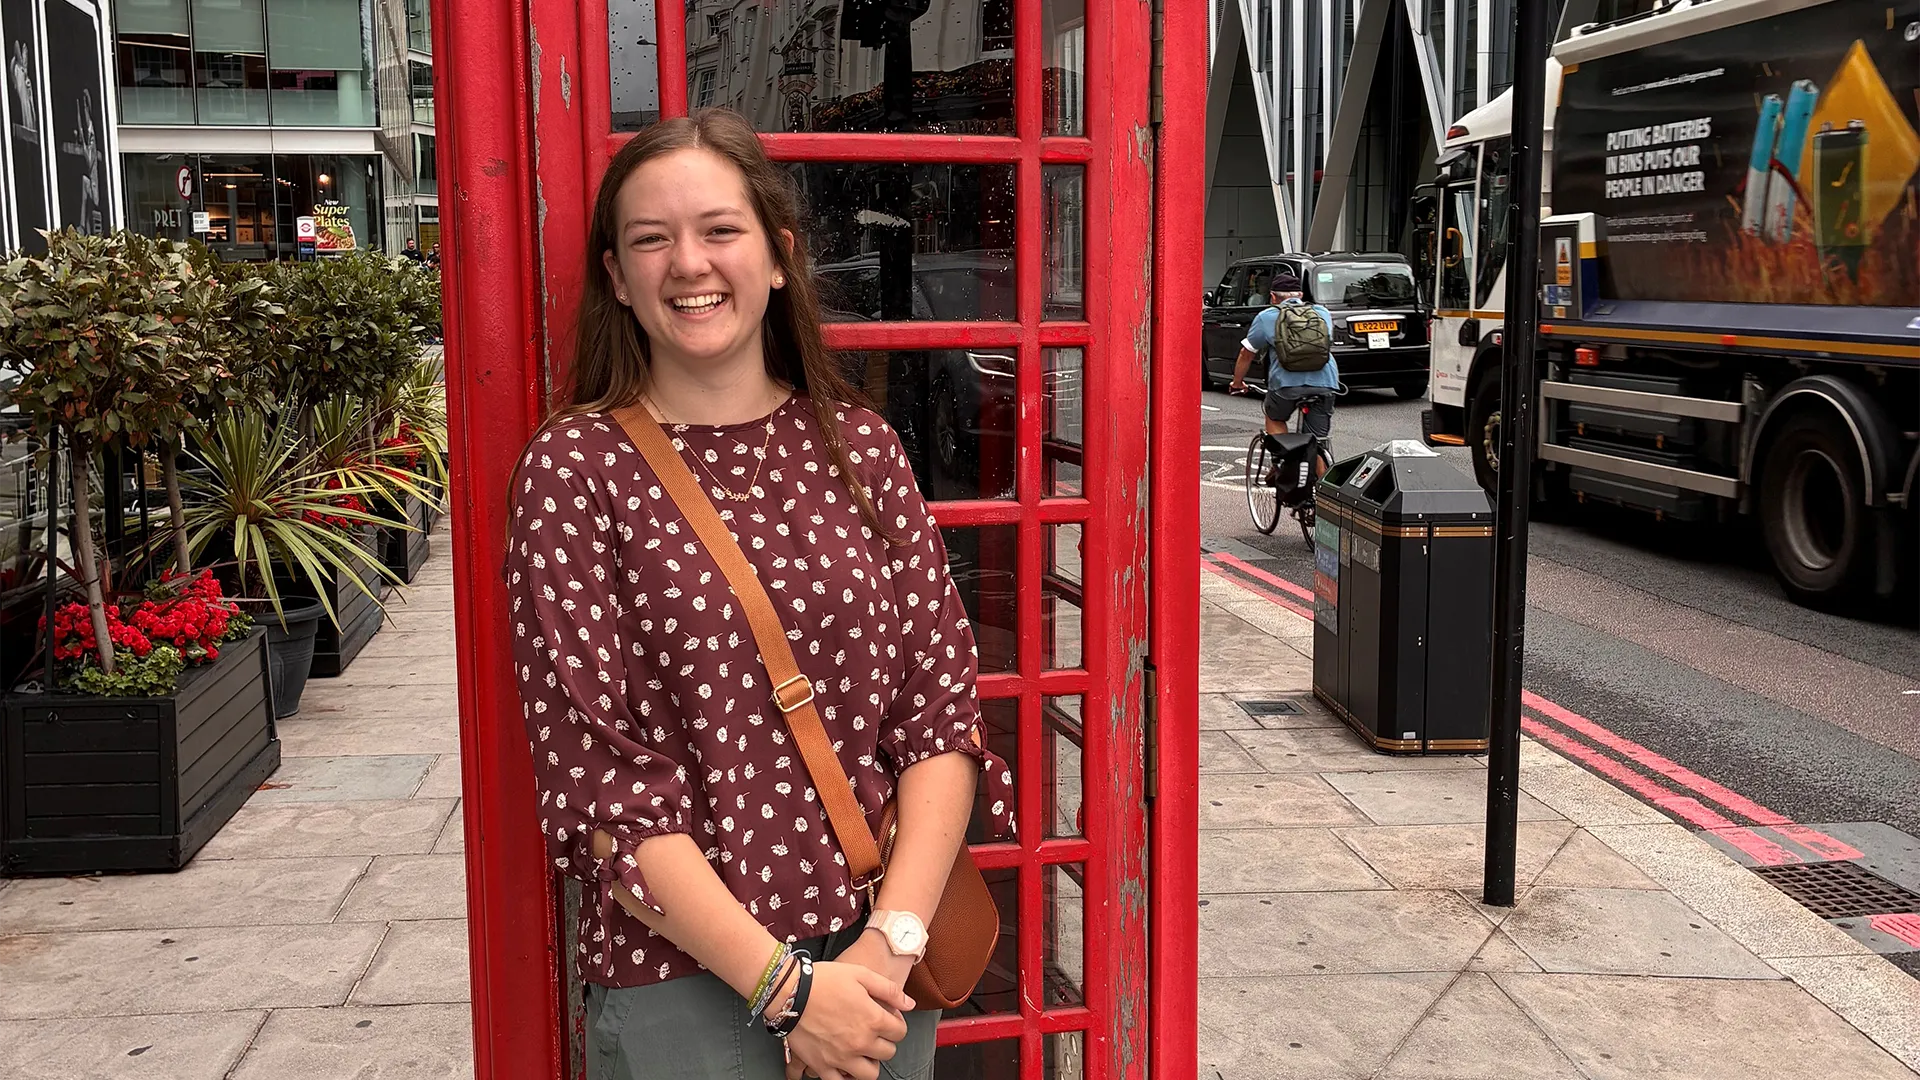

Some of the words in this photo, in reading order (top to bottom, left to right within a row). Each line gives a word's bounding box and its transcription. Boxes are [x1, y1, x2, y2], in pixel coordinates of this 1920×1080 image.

[1606, 127, 1652, 151] PUTTING
[1652, 117, 1712, 145] BATTERIES
[1605, 155, 1619, 175] IN
[1619, 152, 1644, 174] BINS
[1644, 148, 1673, 171] PUTS
[1673, 145, 1701, 168] OUR
[1605, 178, 1642, 199] PEOPLE
[1642, 176, 1656, 196] IN
[1656, 171, 1706, 194] DANGER
[154, 208, 183, 228] PRET
[312, 204, 351, 218] Super
[313, 215, 351, 228] Plates
